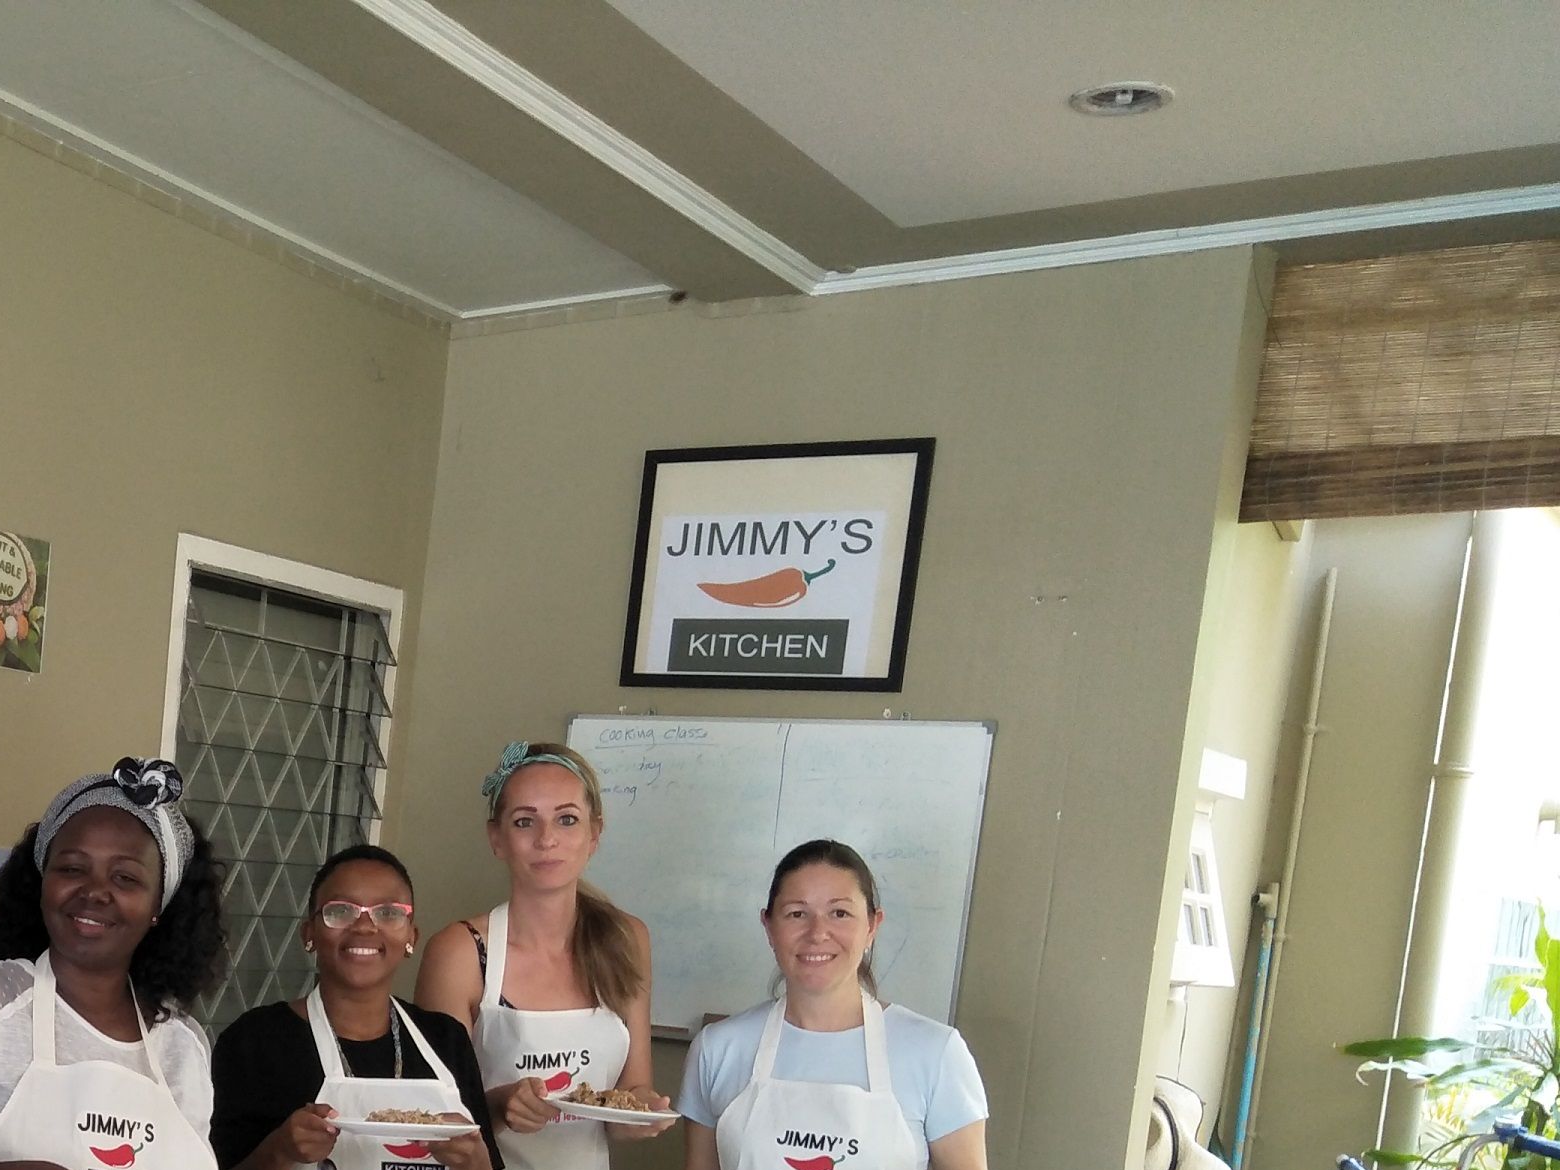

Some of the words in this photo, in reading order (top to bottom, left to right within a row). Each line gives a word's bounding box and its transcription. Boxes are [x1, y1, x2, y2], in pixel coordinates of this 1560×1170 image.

[666, 518, 874, 557] JIMMY'S
[9, 548, 16, 558] &
[688, 633, 828, 658] KITCHEN
